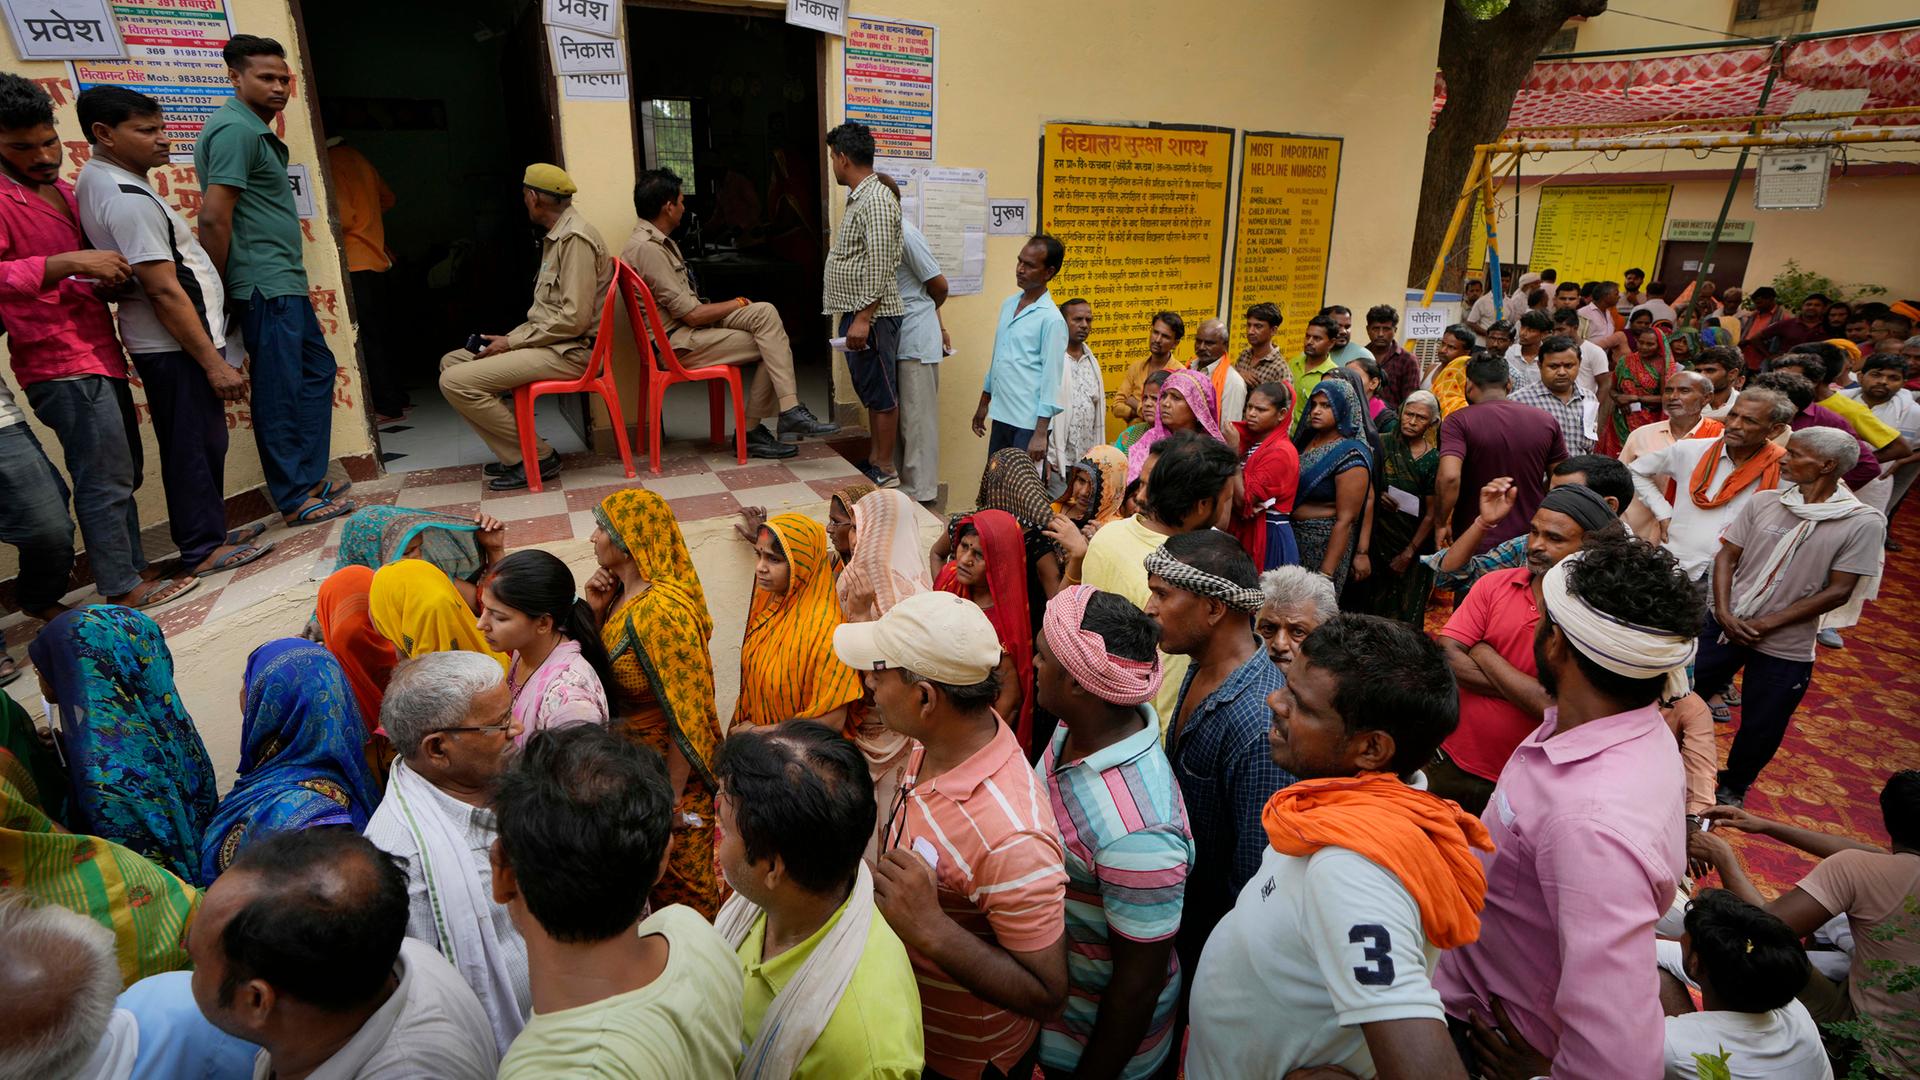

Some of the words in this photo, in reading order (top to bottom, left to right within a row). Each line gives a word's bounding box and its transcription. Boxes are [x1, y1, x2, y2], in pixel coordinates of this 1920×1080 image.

[558, 0, 609, 21] प्रवश
[24, 9, 104, 43] प्रवेश
[128, 24, 168, 36] विद्यालय
[171, 28, 204, 38] कचनार
[850, 29, 865, 39] लोक
[866, 32, 878, 41] सभा
[560, 36, 615, 59] निकास
[849, 38, 867, 49] विधान
[869, 41, 881, 49] सभा
[898, 45, 908, 53] 391
[146, 47, 166, 55] 369
[173, 49, 224, 58] 919817368
[80, 66, 124, 81] नित्यानन्द
[127, 69, 146, 82] सिंह
[178, 74, 231, 84] 983825282
[153, 96, 212, 105] 9454417037
[1058, 127, 1122, 156] विद्यालय
[1124, 134, 1163, 158] सुरक्षा
[1167, 137, 1209, 158] शपथ
[1250, 143, 1274, 158] MOST
[1281, 144, 1330, 160] IMPORTANT
[1251, 162, 1288, 177] HELPLINE
[1290, 164, 1327, 179] NUMBERS
[1250, 186, 1264, 195] FIRE
[1249, 196, 1283, 206] AMBULANCE
[1248, 207, 1265, 216] CHILD
[1265, 207, 1290, 216] HELPLINE
[1247, 218, 1268, 226] WOMEN
[1268, 218, 1292, 226] HELPLINE
[1673, 221, 1689, 229] HEAD
[1258, 238, 1283, 246] HELPLINE
[1412, 312, 1441, 323] पोलिंग
[1348, 924, 1395, 986] 3
